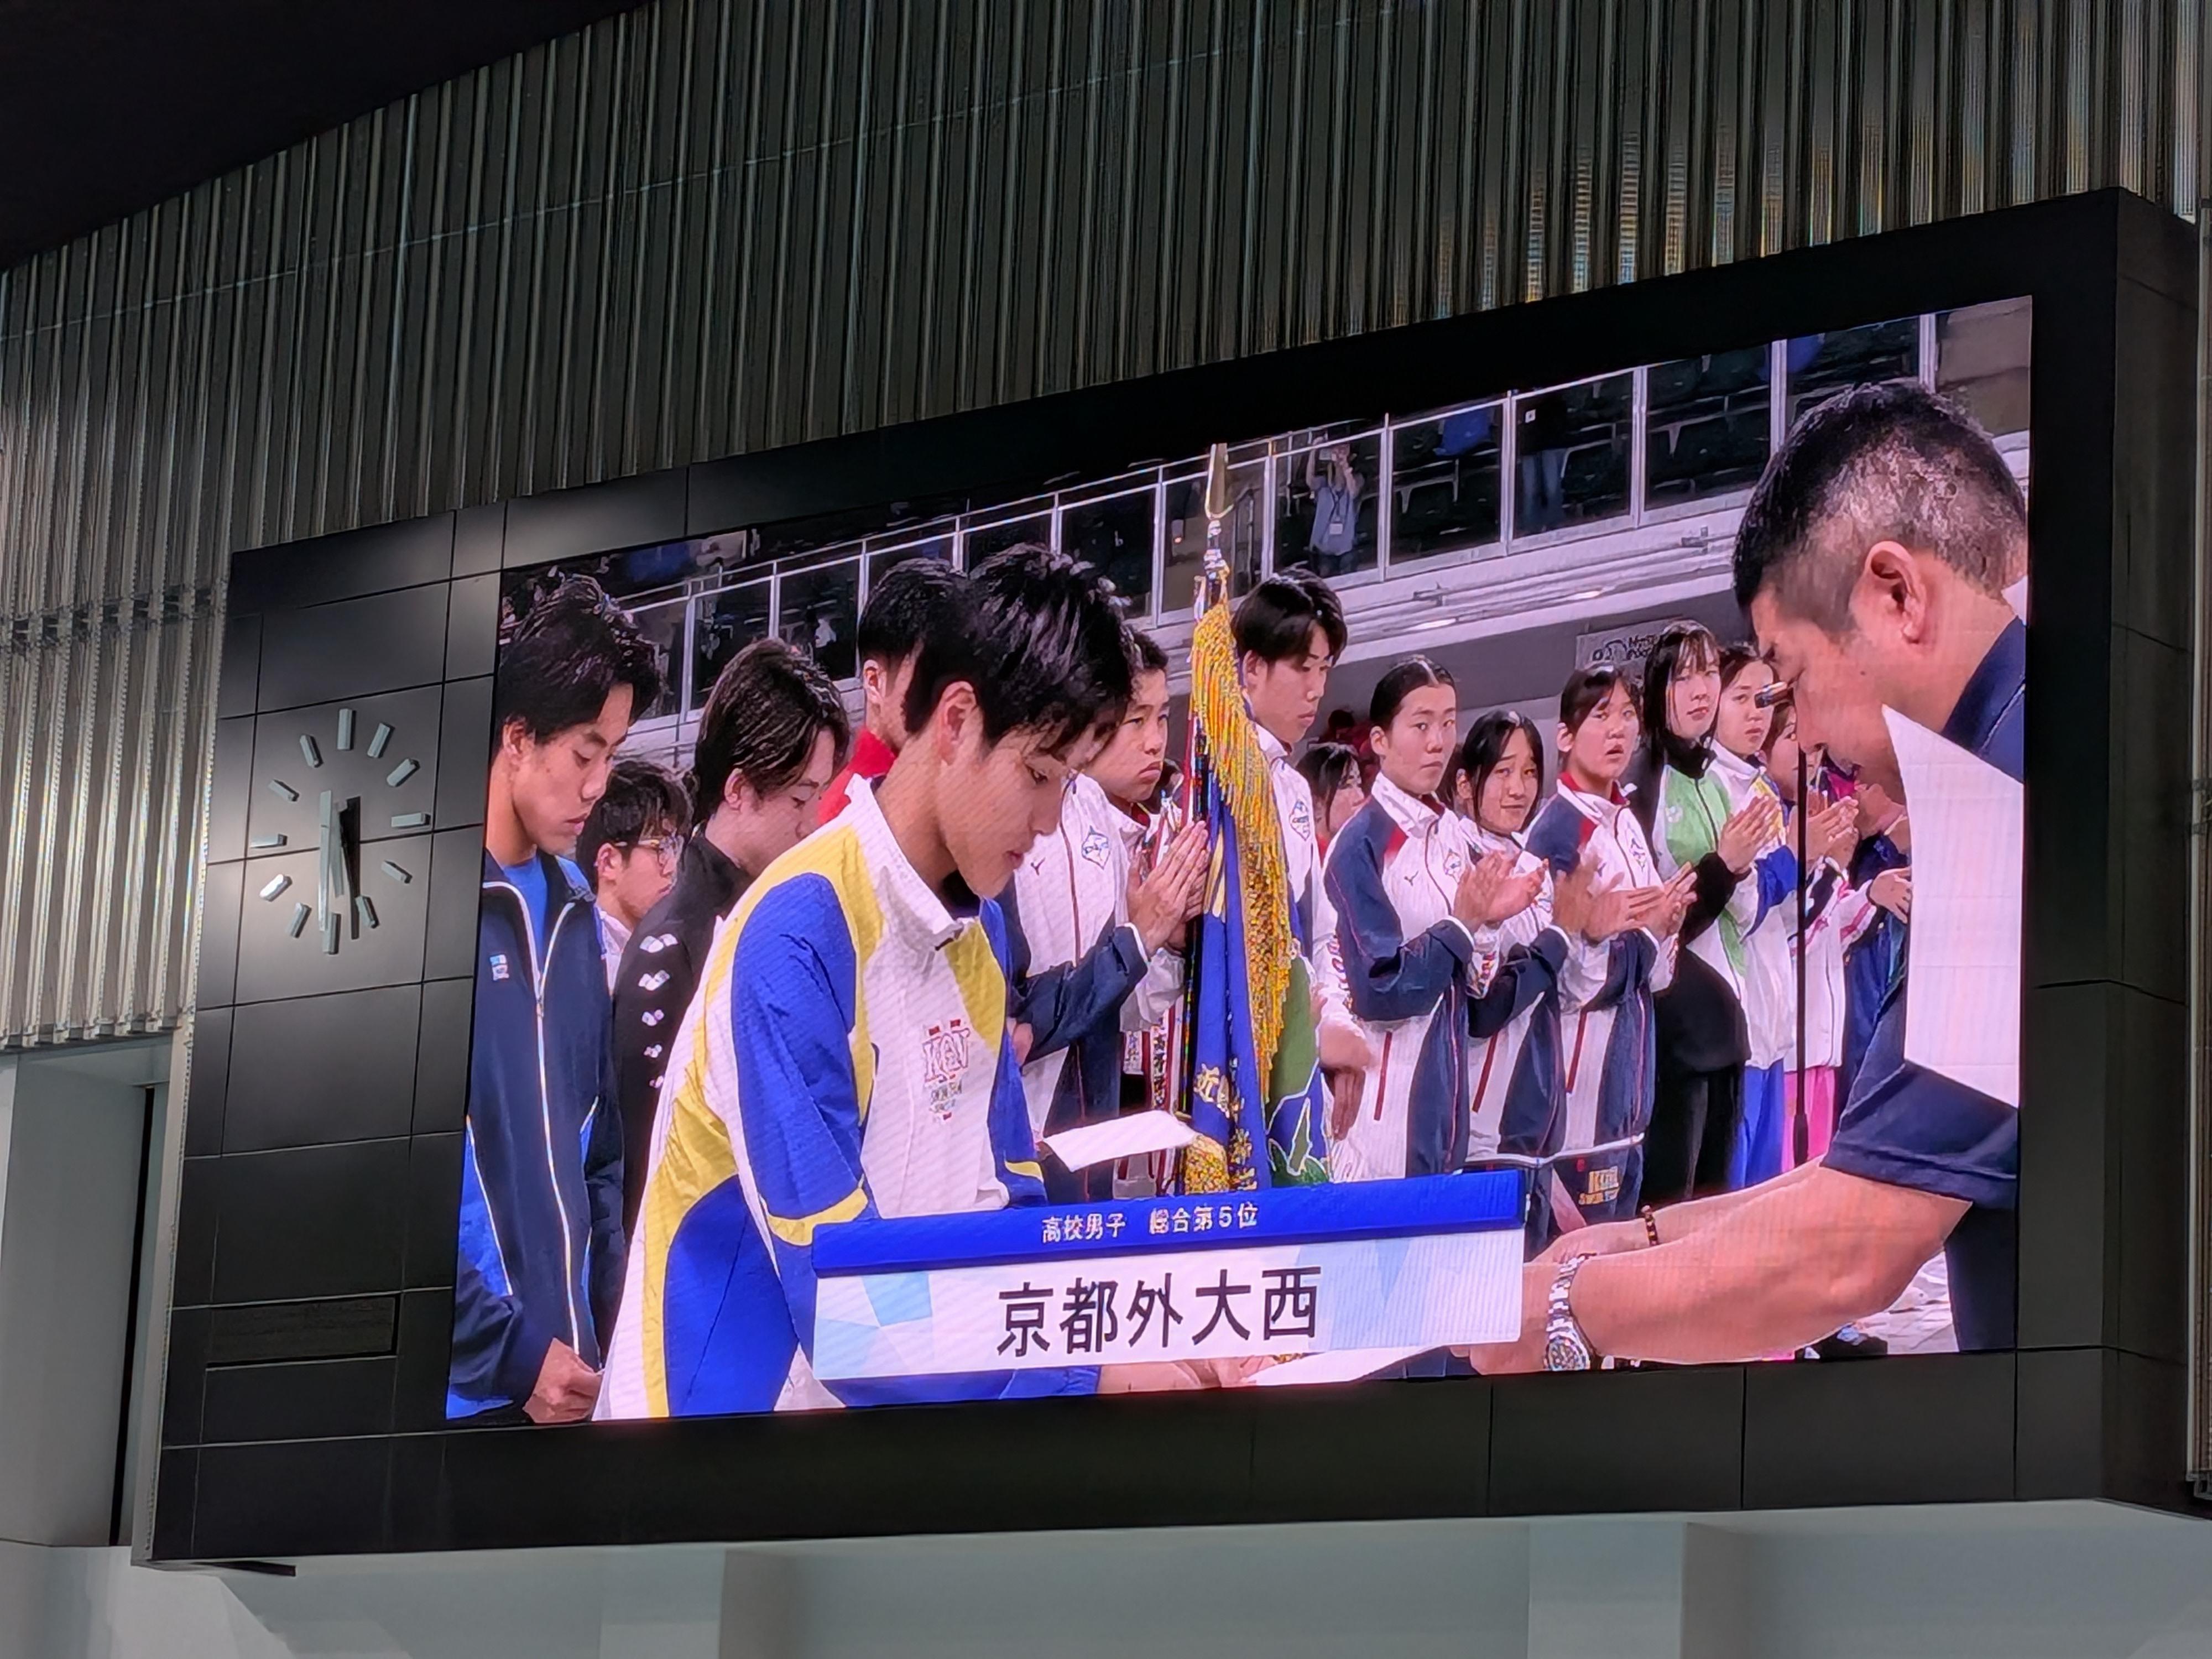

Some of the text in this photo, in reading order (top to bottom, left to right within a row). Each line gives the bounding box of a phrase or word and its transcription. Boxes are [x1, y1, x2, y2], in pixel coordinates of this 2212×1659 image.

[1042, 1213, 1126, 1244] 高校男子
[997, 1266, 1321, 1357] 京都外大西
